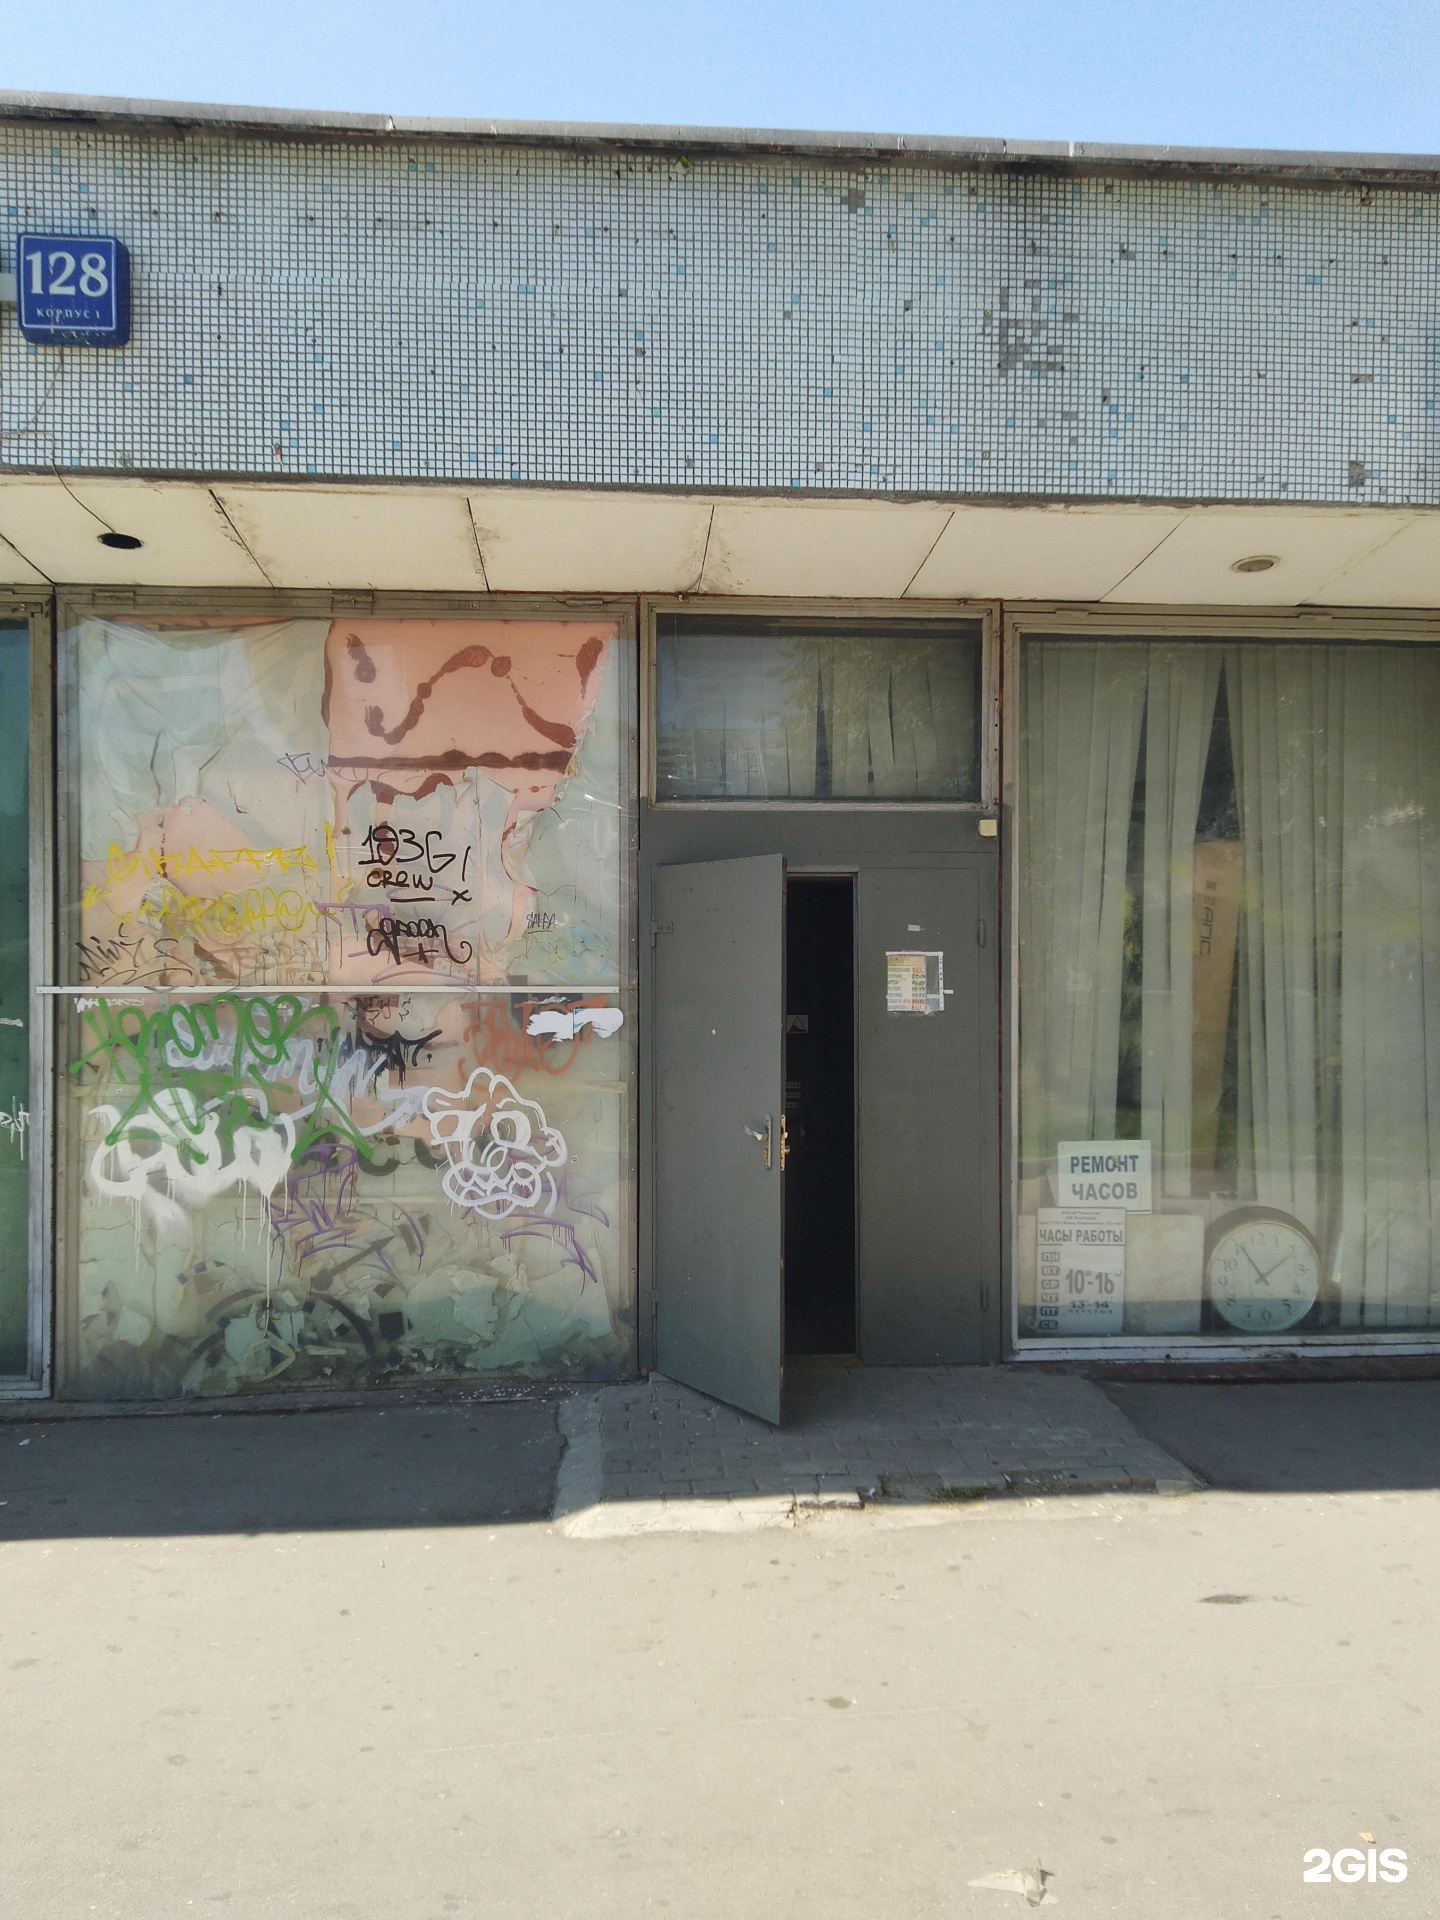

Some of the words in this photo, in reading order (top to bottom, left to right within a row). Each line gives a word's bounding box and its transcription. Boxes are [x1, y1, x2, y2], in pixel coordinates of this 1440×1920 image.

[26, 251, 108, 297] 128
[1071, 1155, 1139, 1174] РЕМОНТ
[1071, 1182, 1138, 1200] ЧАСОВ
[1039, 1229, 1072, 1242] ЧАСЫ
[1076, 1229, 1123, 1243] РАБОТЫ
